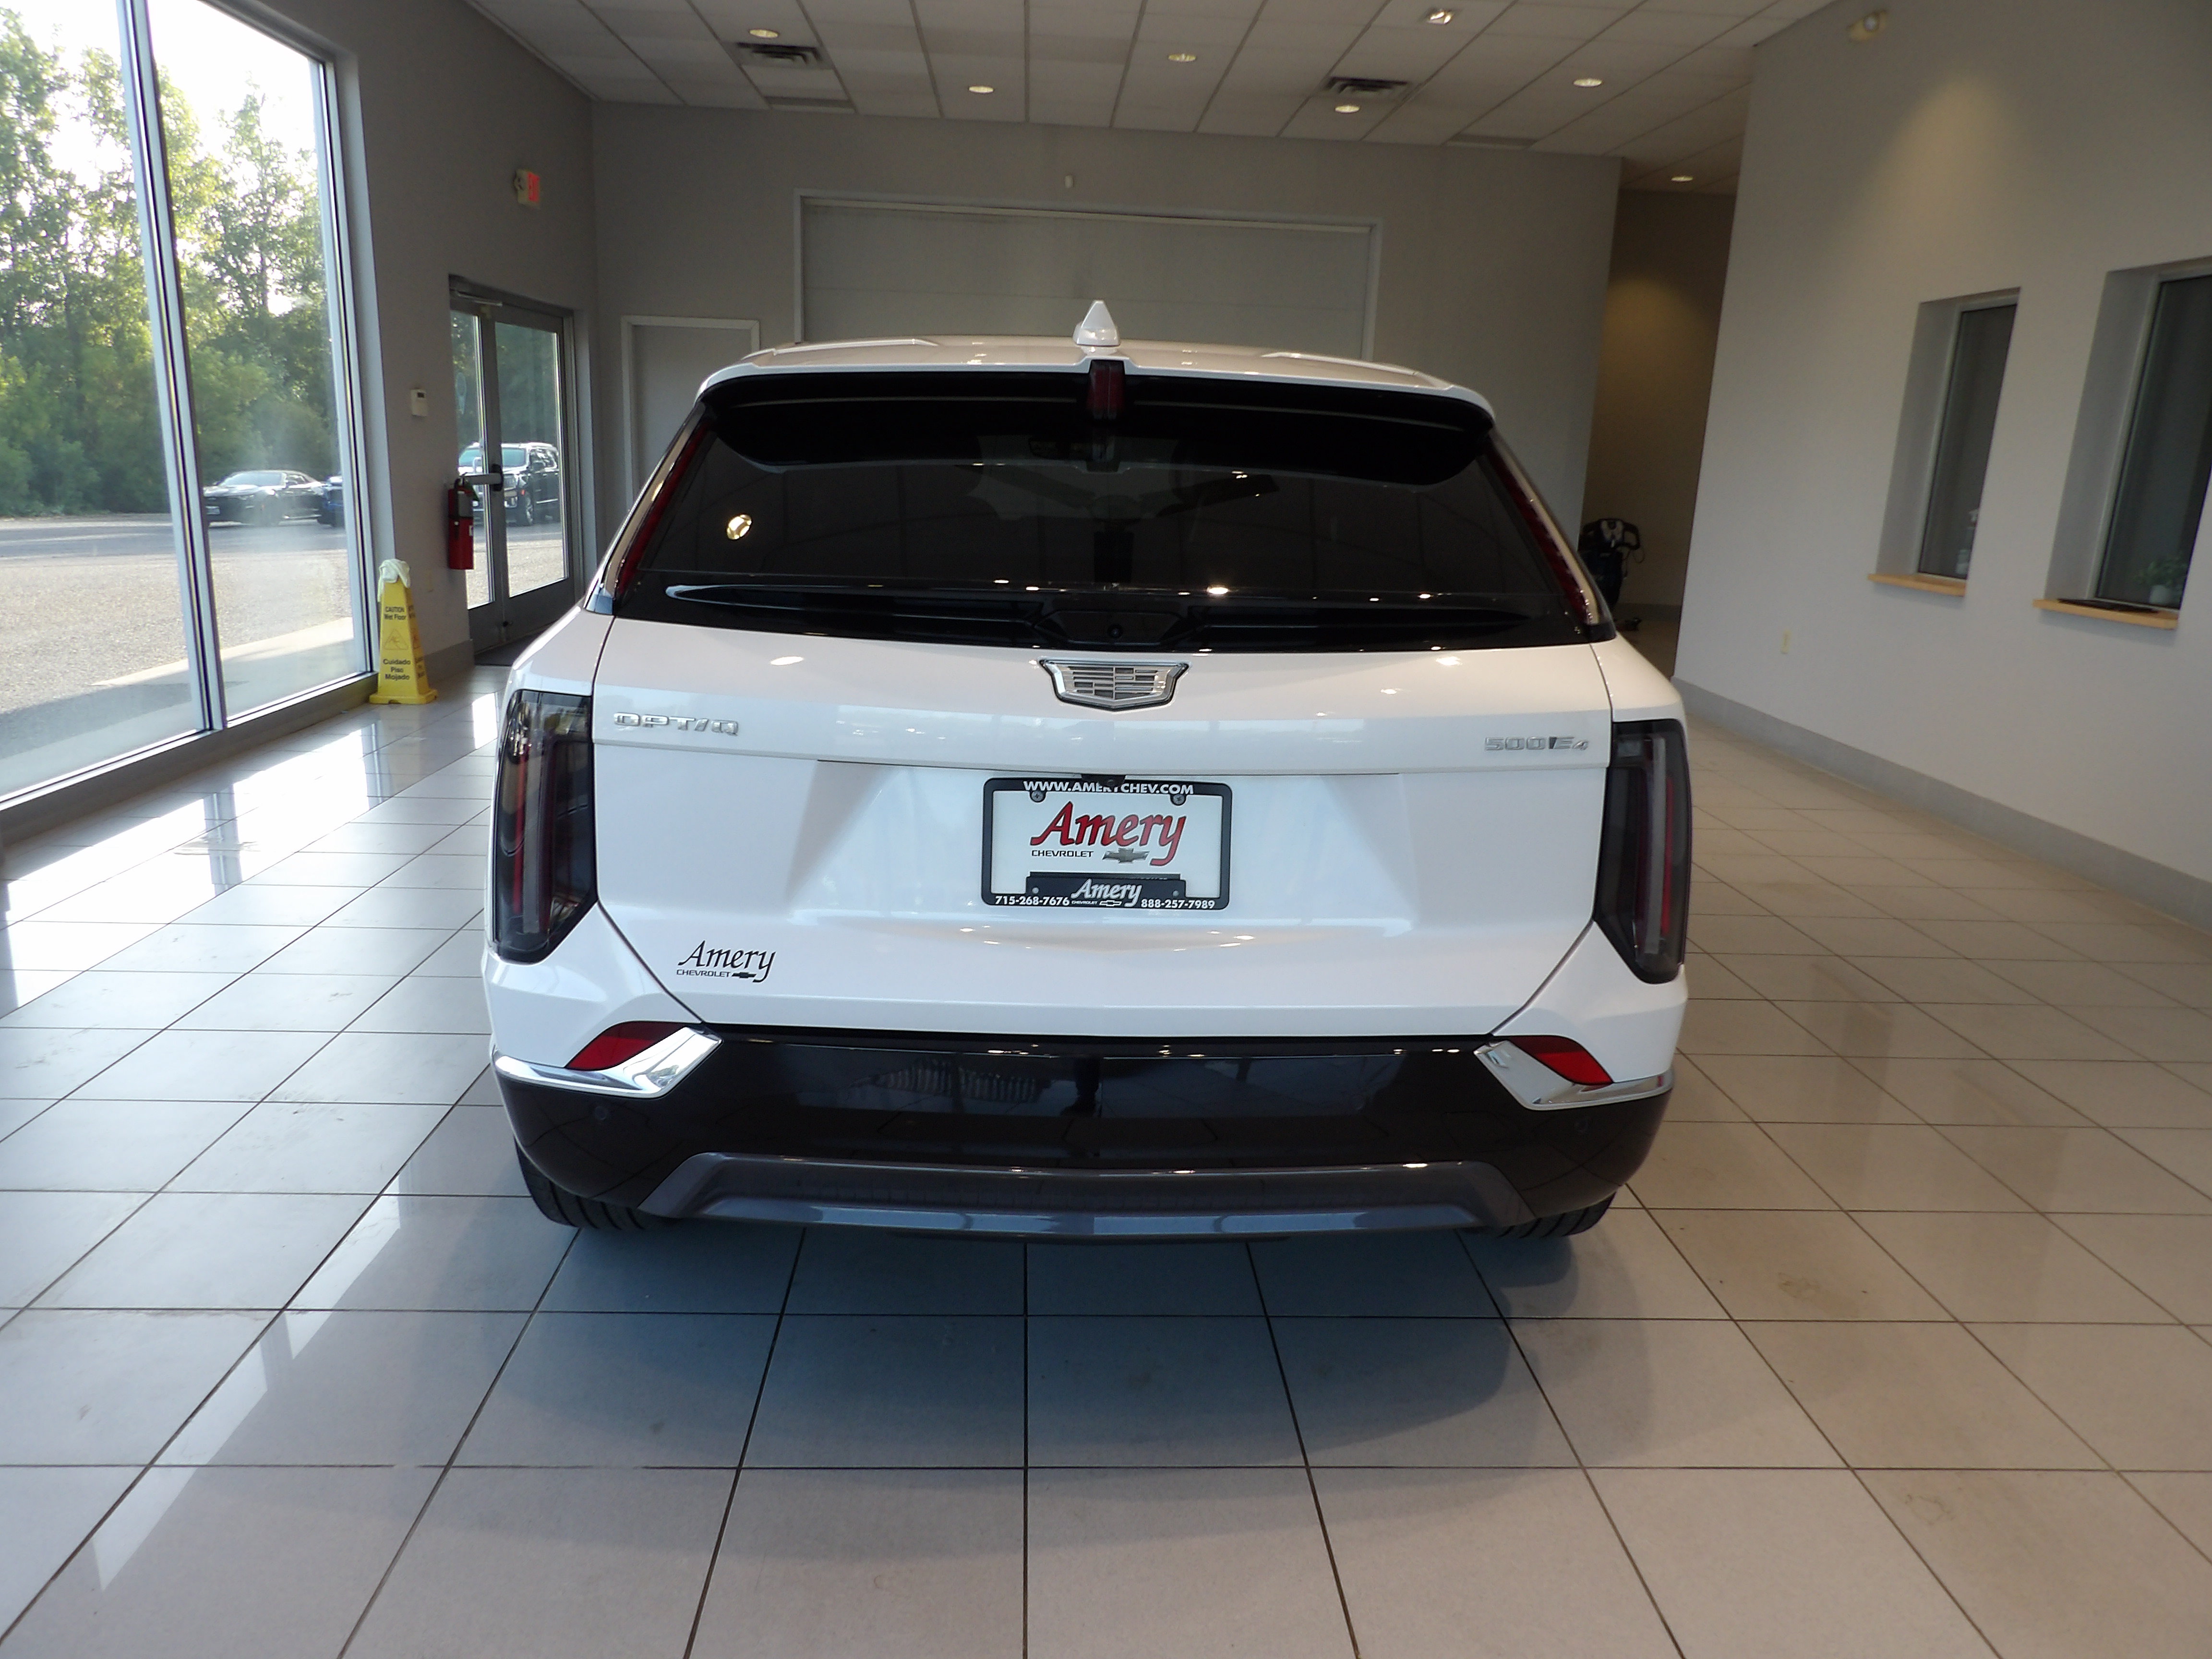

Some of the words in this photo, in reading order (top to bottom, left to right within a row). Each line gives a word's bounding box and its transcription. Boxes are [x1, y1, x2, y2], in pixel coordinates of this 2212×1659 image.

[1030, 800, 1187, 866] Amery
[1031, 849, 1094, 858] CHEVROLET
[1070, 878, 1142, 908] Amery
[995, 895, 1070, 906] 715-268-7676
[1141, 899, 1215, 909] 888-257-7989
[677, 939, 776, 983] Amery
[676, 969, 731, 978] CHEVROLET
